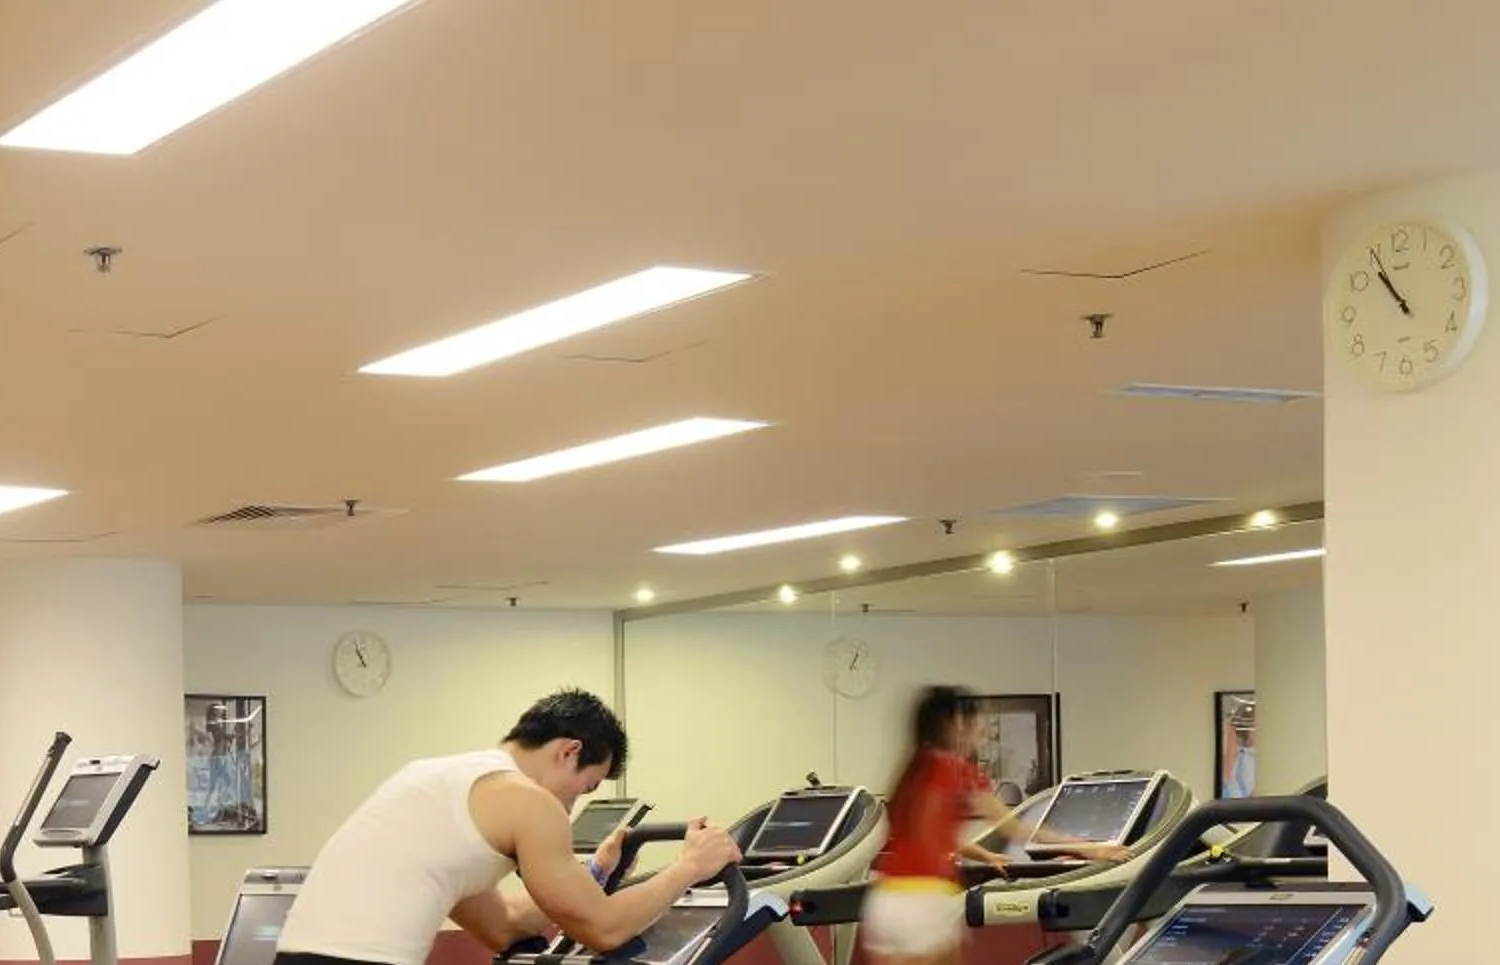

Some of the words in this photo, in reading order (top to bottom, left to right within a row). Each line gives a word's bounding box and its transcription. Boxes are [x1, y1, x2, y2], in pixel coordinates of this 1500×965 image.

[1390, 229, 1410, 253] 12
[1439, 244, 1456, 270] 2
[1451, 276, 1467, 301] 3
[1340, 305, 1357, 327] 9
[1444, 309, 1458, 333] 4
[1350, 332, 1366, 357] 8
[1422, 338, 1440, 364] 5
[1373, 350, 1387, 372] 7
[1398, 354, 1414, 375] 6
